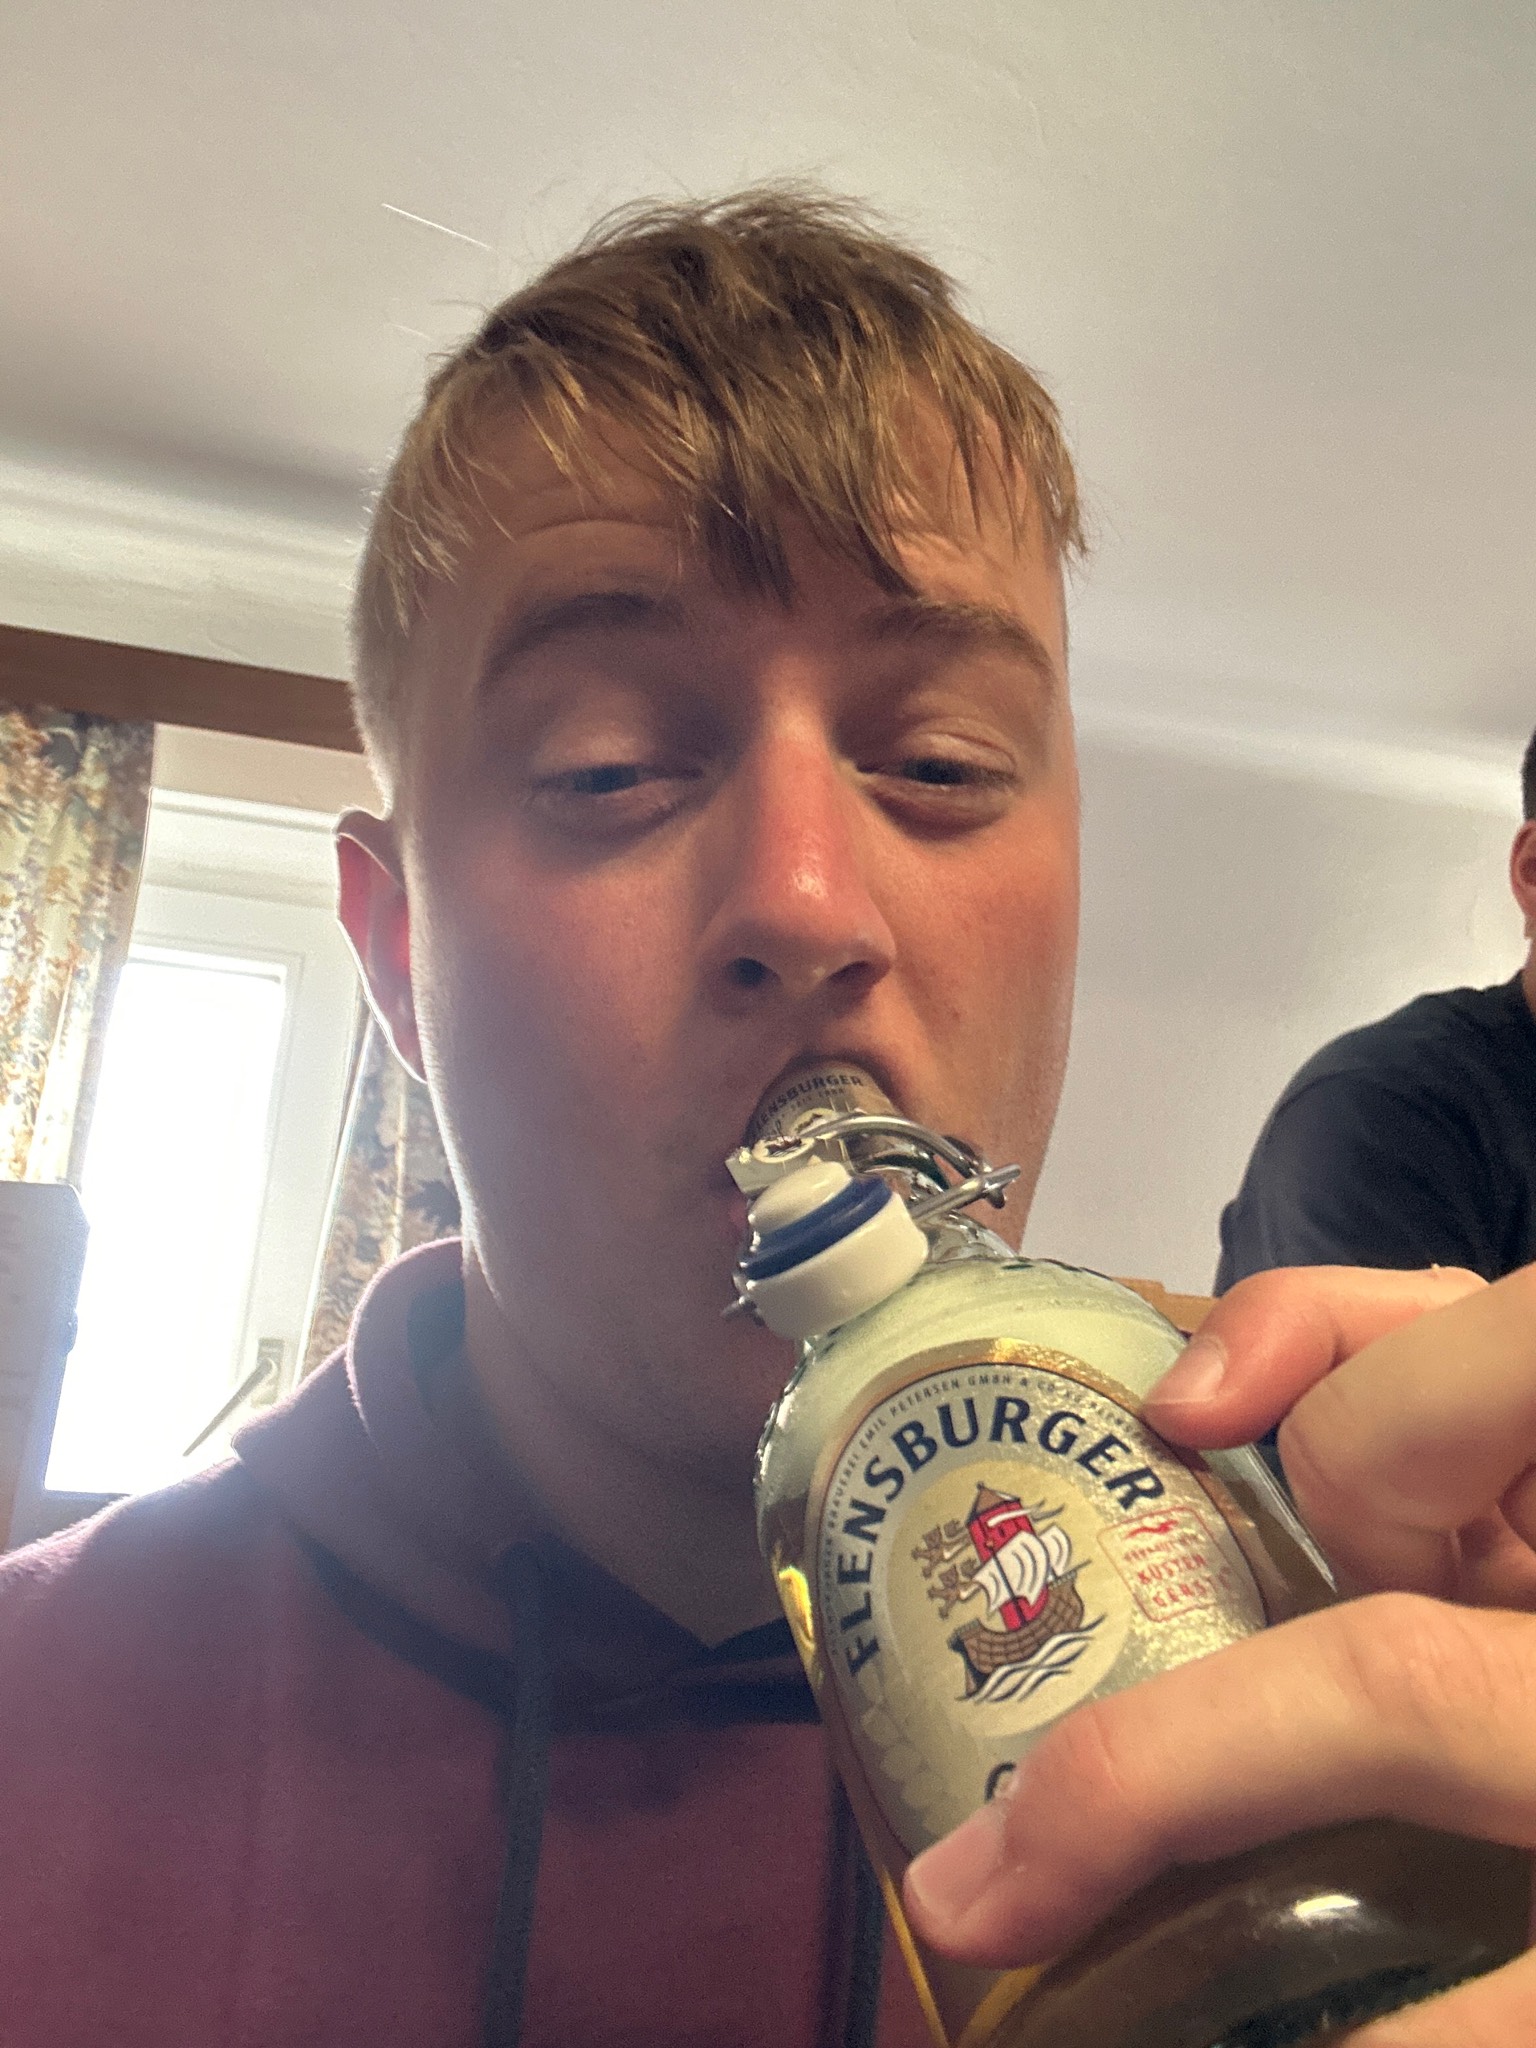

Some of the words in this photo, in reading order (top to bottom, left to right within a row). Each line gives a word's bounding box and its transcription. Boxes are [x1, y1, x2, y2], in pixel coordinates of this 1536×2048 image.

[858, 1417, 887, 1450] EMIL
[888, 1377, 961, 1418] PETERSEN
[835, 1395, 1167, 1678] FLENSBURGER
